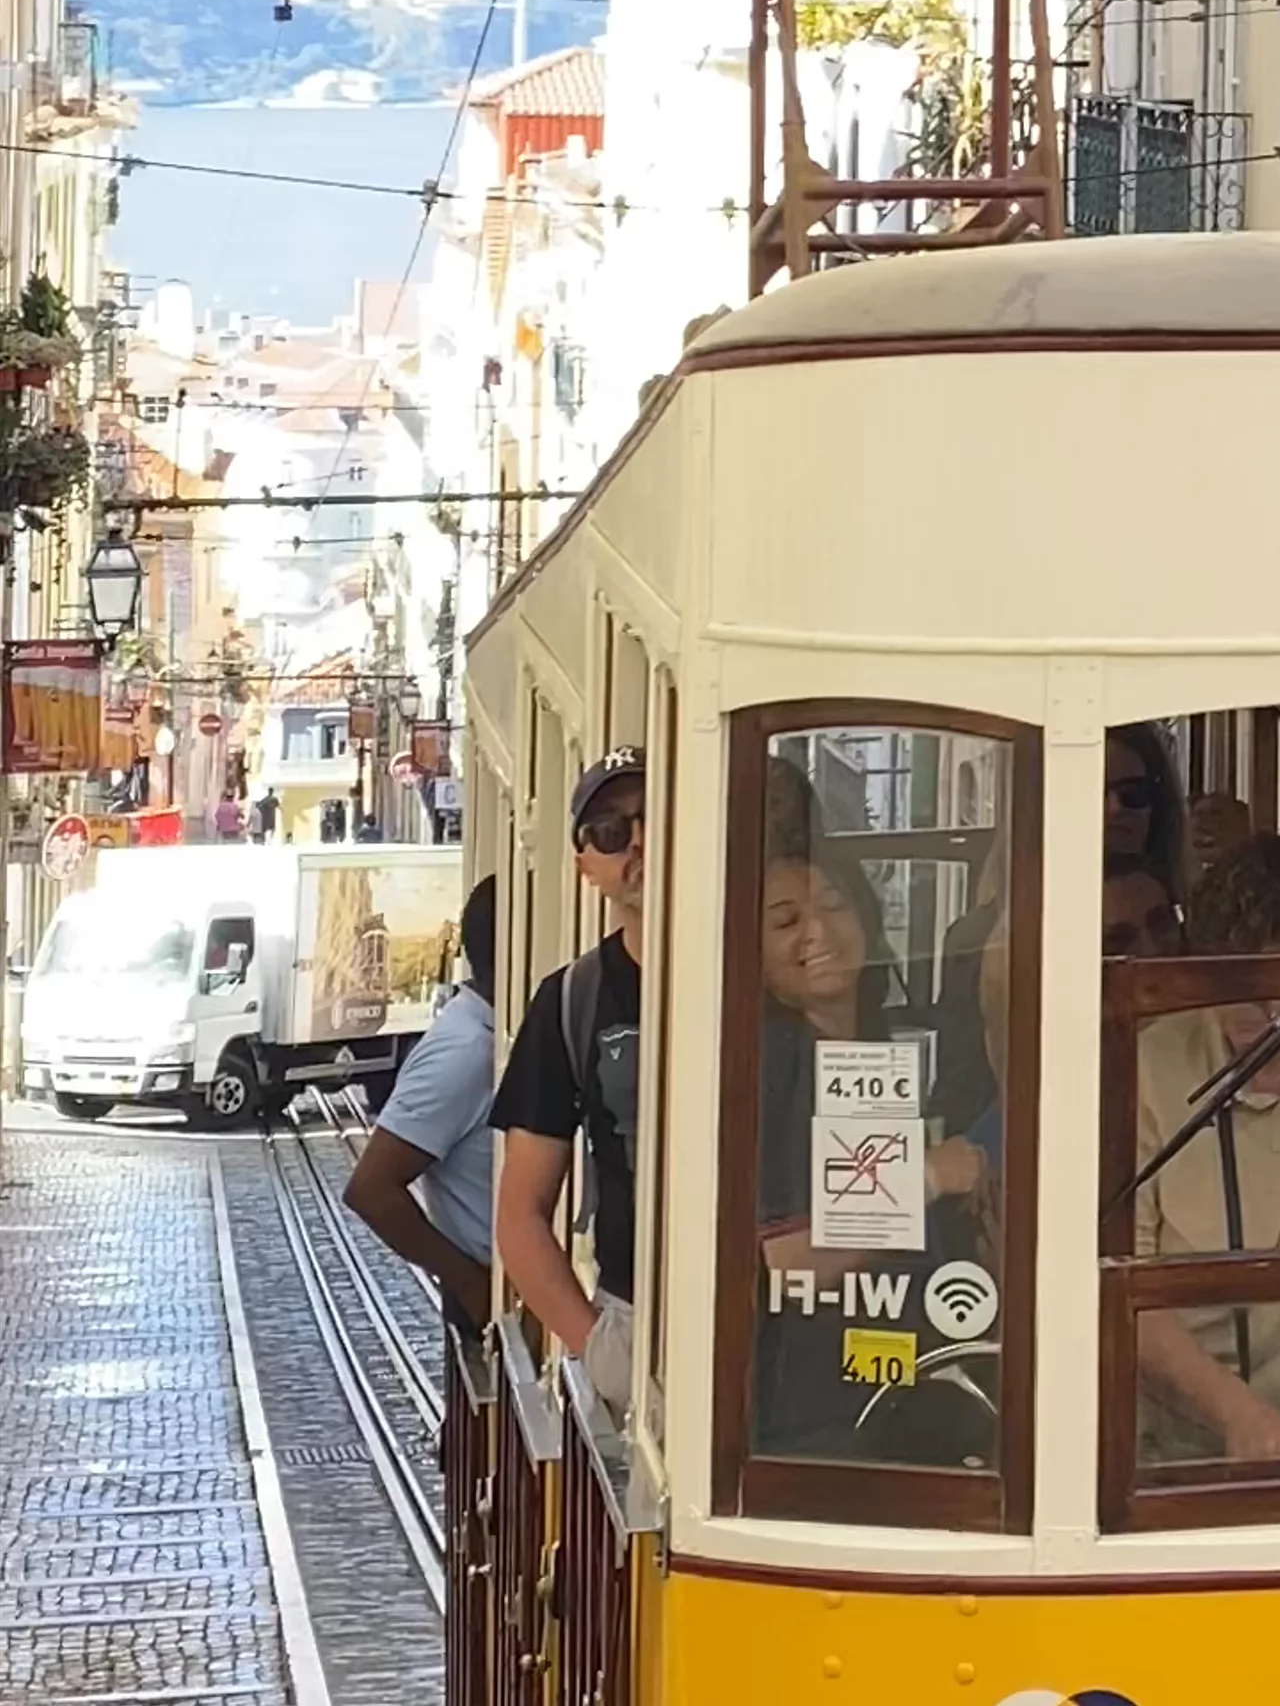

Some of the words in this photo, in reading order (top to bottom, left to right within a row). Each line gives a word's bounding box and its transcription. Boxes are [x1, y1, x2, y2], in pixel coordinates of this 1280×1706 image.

[826, 1077, 884, 1099] 4.10
[893, 1078, 911, 1099] €
[842, 1353, 903, 1384] 4.10
